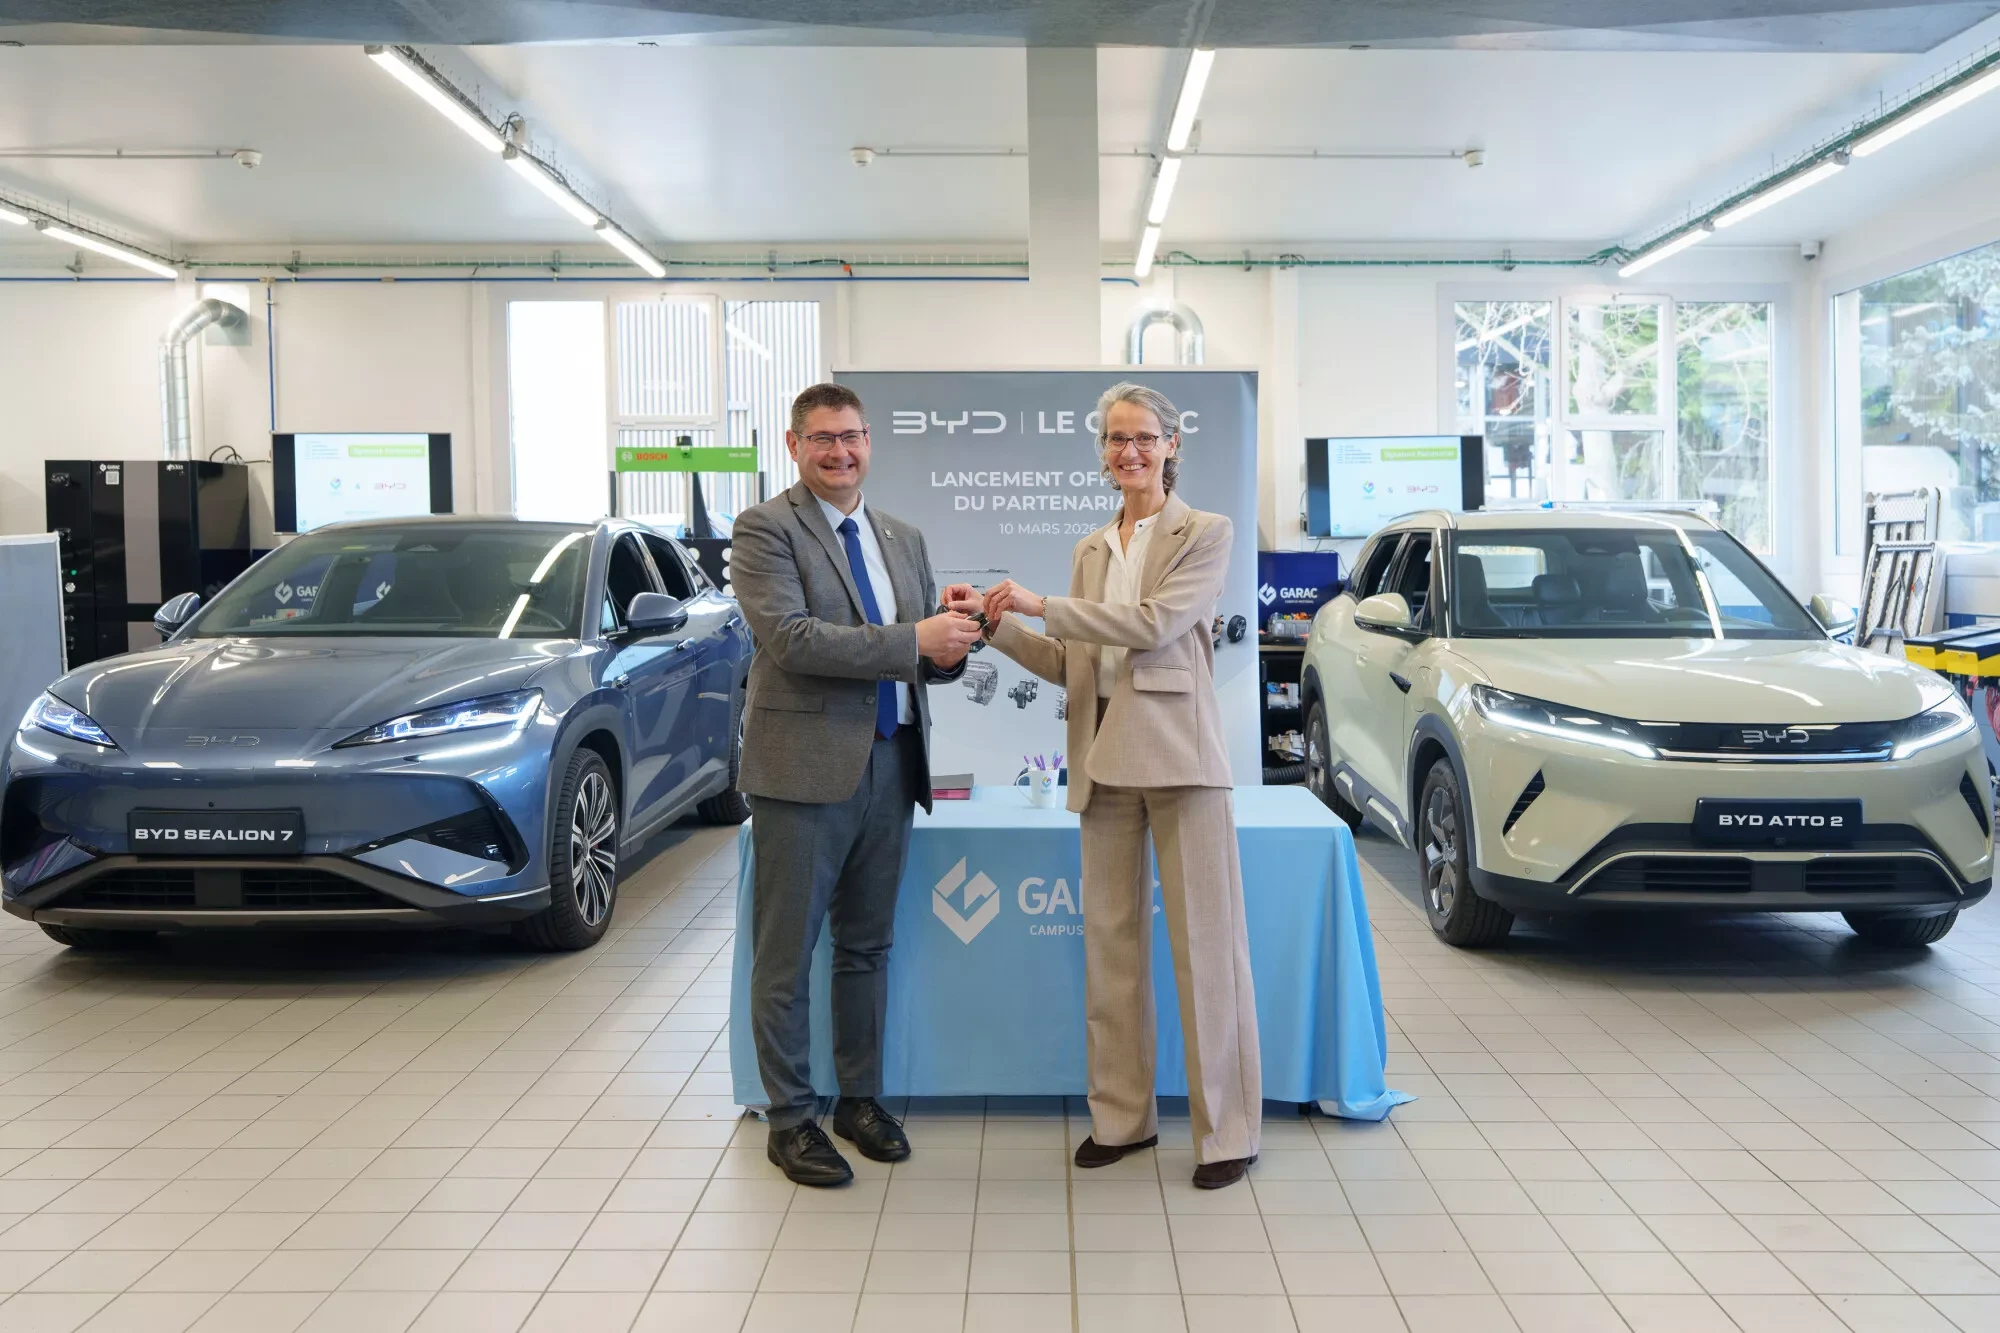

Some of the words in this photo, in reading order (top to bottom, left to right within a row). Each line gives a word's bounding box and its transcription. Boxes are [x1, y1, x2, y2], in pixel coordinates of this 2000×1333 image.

[892, 410, 1007, 434] BYD
[1037, 410, 1076, 434] LE
[636, 452, 668, 461] BOSCH
[931, 471, 1063, 487] LANCEMENT
[954, 495, 985, 511] DU
[992, 495, 1125, 511] PARTENARIA
[998, 522, 1014, 535] 10
[1018, 522, 1061, 535] MARS
[1063, 522, 1098, 535] 2026
[1279, 587, 1318, 599] GARAC
[1741, 729, 1810, 744] BYD
[1718, 814, 1764, 826] BYD
[1768, 815, 1825, 827] ATTO
[1830, 815, 1844, 827] 2
[135, 828, 179, 840] BYD
[184, 829, 275, 841] SEALION
[280, 830, 293, 841] 7
[1029, 924, 1084, 936] CAMPUS
